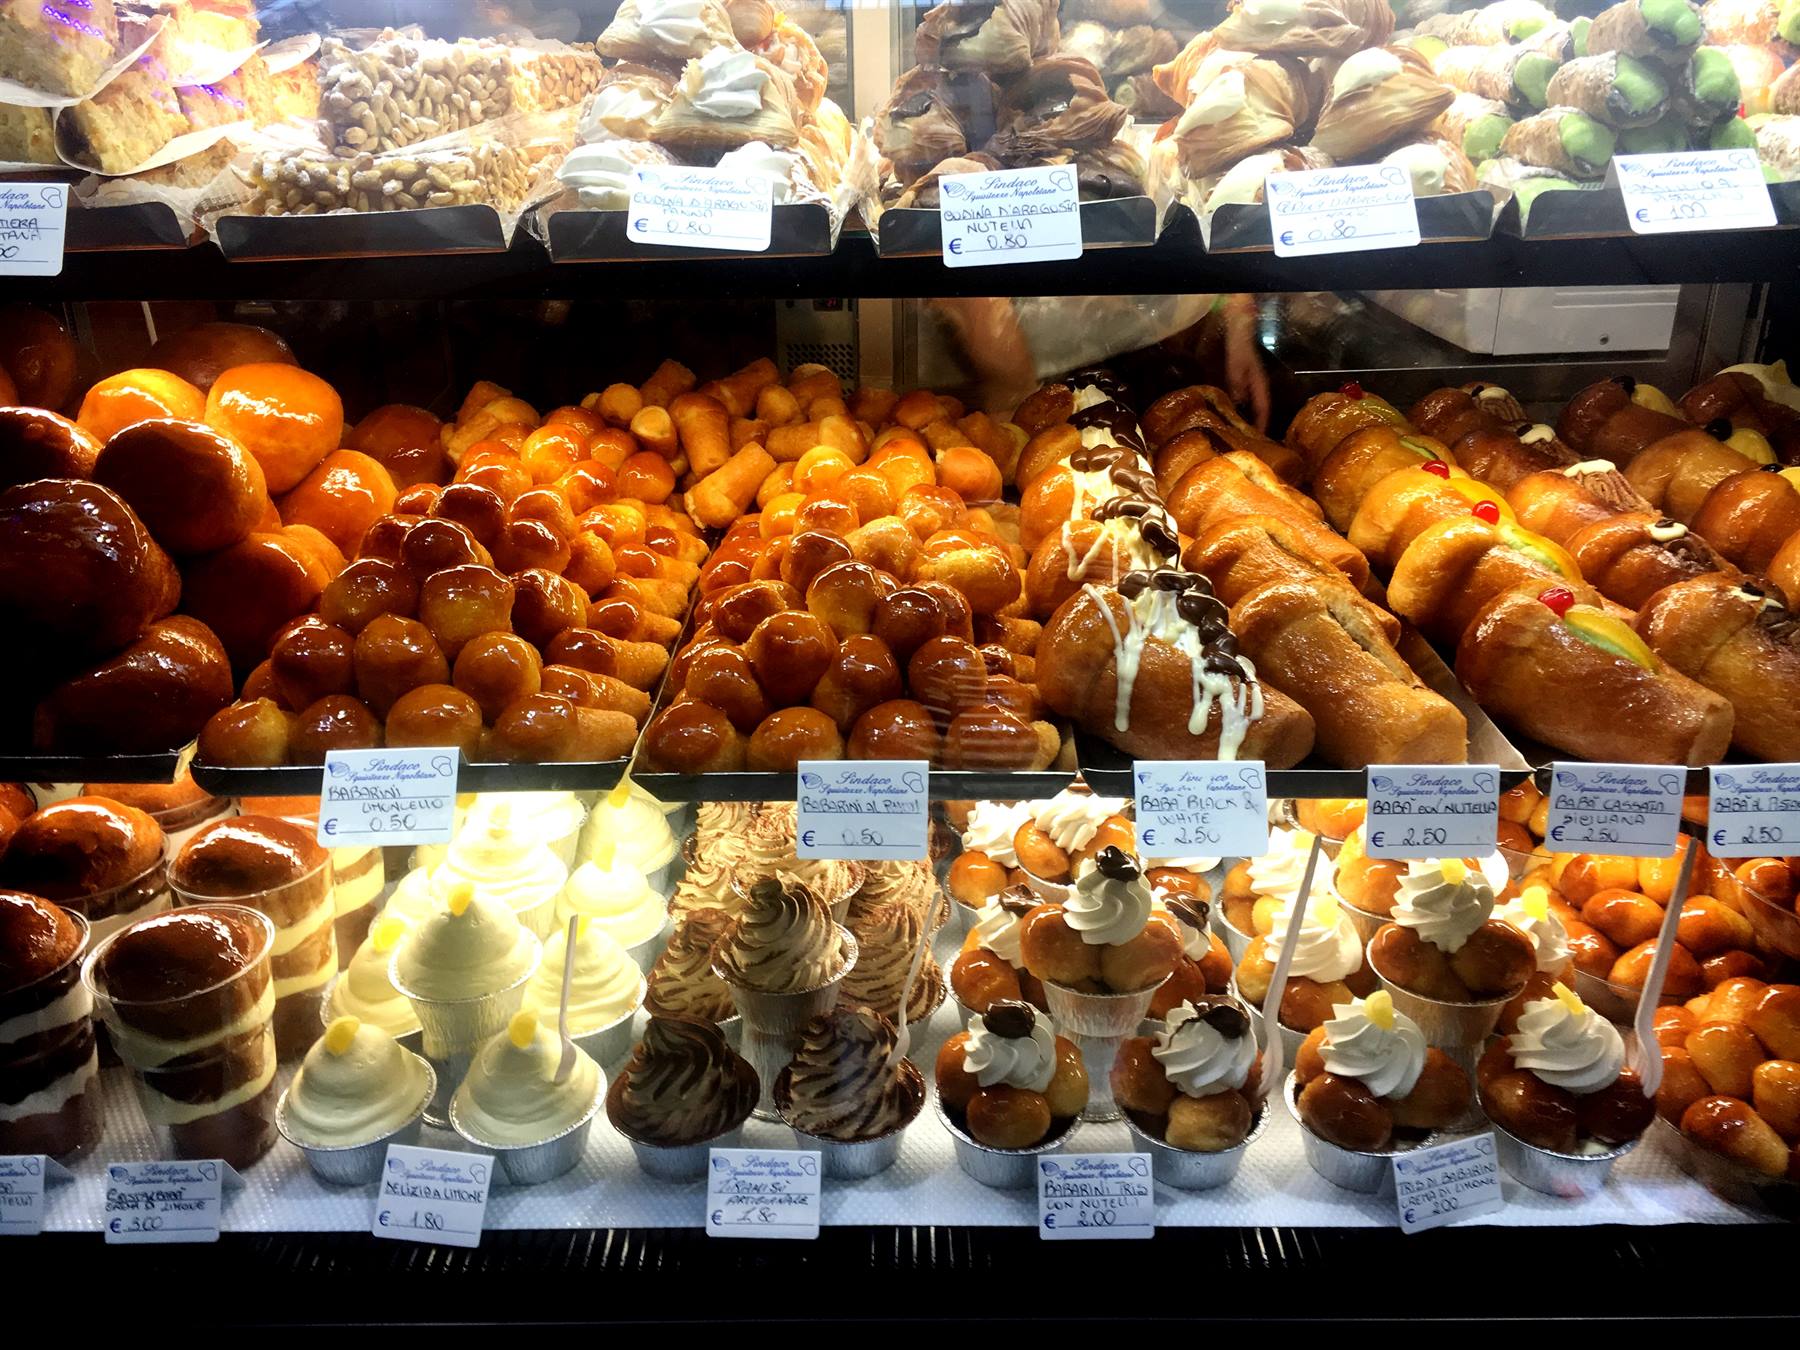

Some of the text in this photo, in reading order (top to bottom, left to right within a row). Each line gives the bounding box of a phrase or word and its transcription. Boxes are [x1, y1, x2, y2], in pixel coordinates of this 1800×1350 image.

[980, 177, 1038, 190] Sindaco
[1309, 174, 1369, 187] Sindaco
[948, 238, 962, 255] €
[364, 759, 420, 772] Sindaco
[836, 771, 891, 785] Sindaco
[1406, 774, 1462, 786] Sindaco
[1591, 771, 1647, 785] Sindaco
[324, 818, 338, 835] €
[1551, 826, 1566, 841] €
[802, 830, 815, 847] €
[1142, 829, 1155, 846] €
[1371, 827, 1447, 847] € 2.50
[1713, 830, 1727, 846] €
[415, 1159, 462, 1173] Sindaco
[742, 1155, 789, 1167] Sindaco
[1071, 1159, 1120, 1170] Sindaco
[140, 1163, 189, 1176] Sindaco
[379, 1210, 391, 1227] €
[711, 1210, 723, 1226] €
[1044, 1214, 1056, 1229] €
[1404, 1209, 1416, 1223] €
